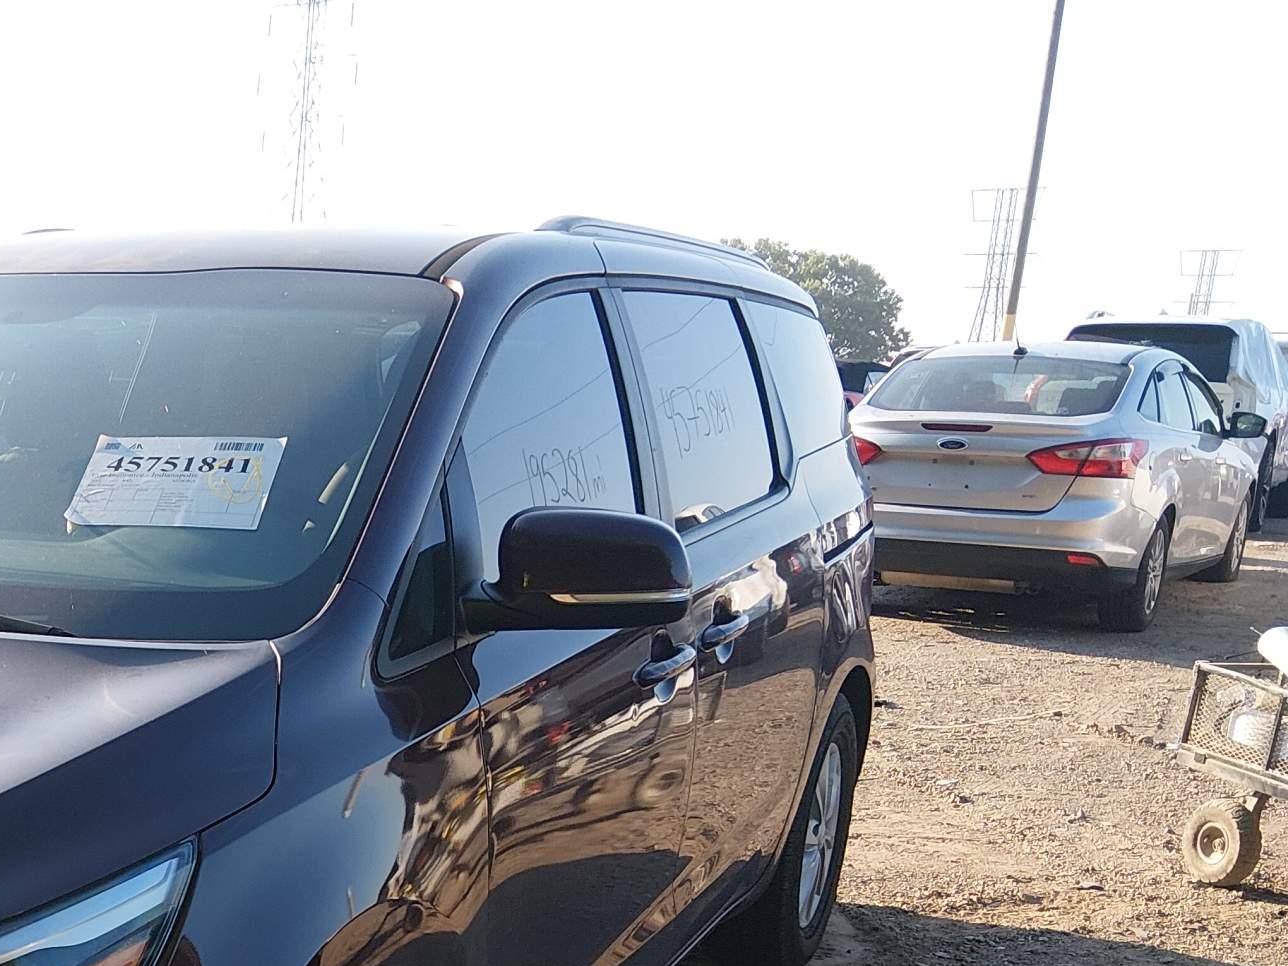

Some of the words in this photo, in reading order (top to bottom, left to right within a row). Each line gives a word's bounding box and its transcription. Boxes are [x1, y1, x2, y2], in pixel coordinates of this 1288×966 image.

[659, 386, 736, 459] 45751841
[106, 456, 251, 473] 45751841
[522, 447, 592, 507] 195281
